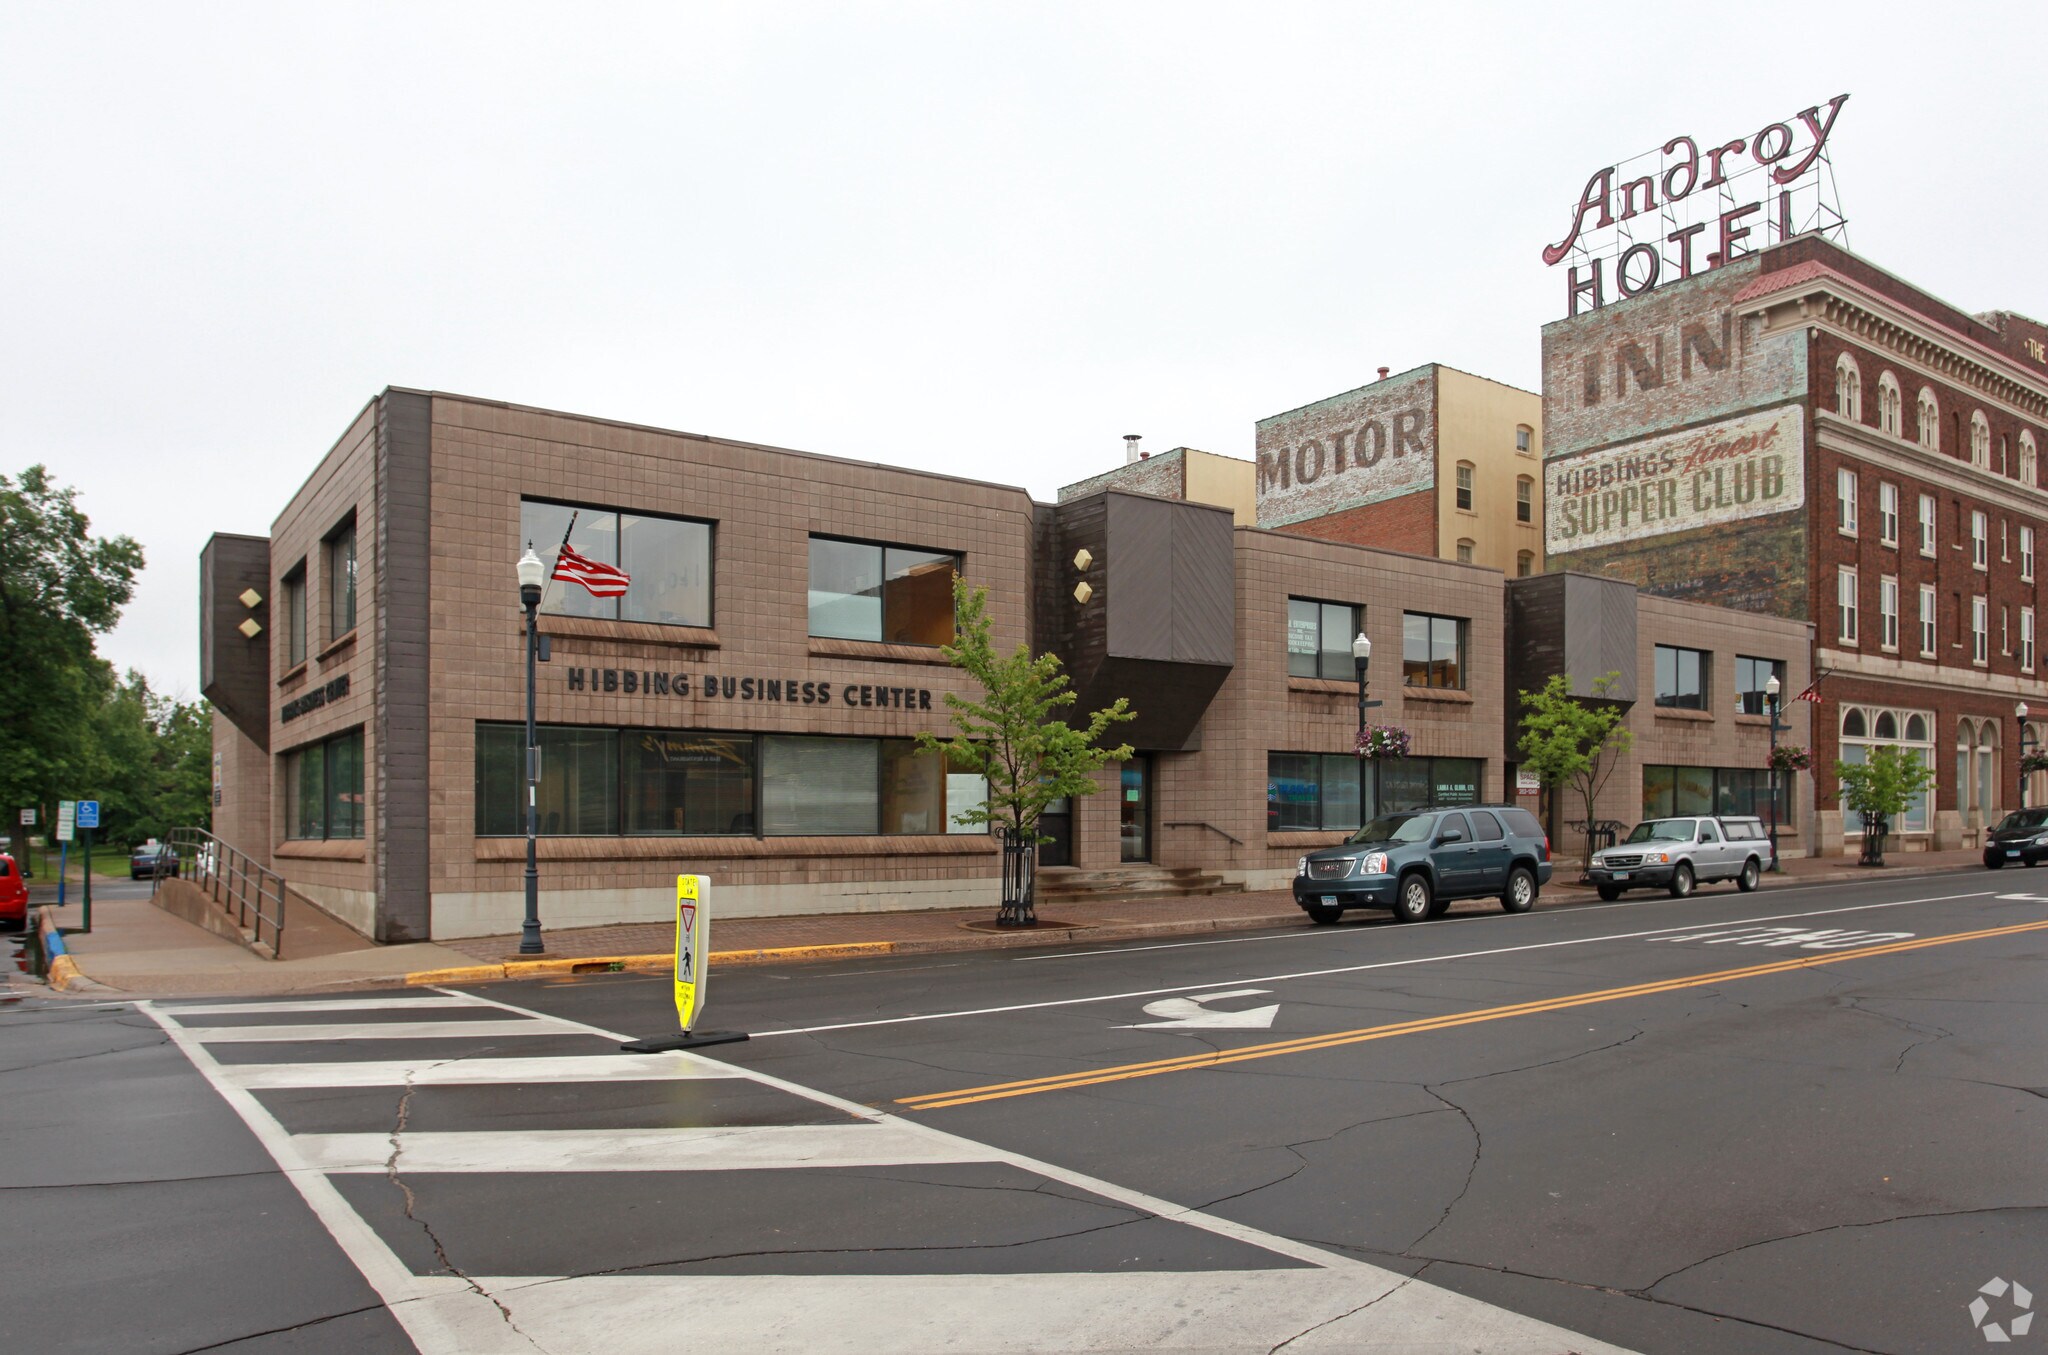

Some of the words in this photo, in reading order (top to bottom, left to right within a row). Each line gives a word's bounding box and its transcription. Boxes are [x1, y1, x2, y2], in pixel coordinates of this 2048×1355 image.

[1542, 94, 1850, 266] Androy
[1583, 312, 1732, 408] INN
[2028, 337, 2047, 365] THE
[1260, 407, 1425, 494] MOTOR
[1557, 450, 1674, 496] HIBBINGS
[1561, 477, 1677, 538] SUPPER
[1693, 454, 1783, 512] CLUB
[568, 667, 689, 696] HIBBING
[704, 675, 831, 704] BUSINESS
[843, 685, 932, 710] CENTER
